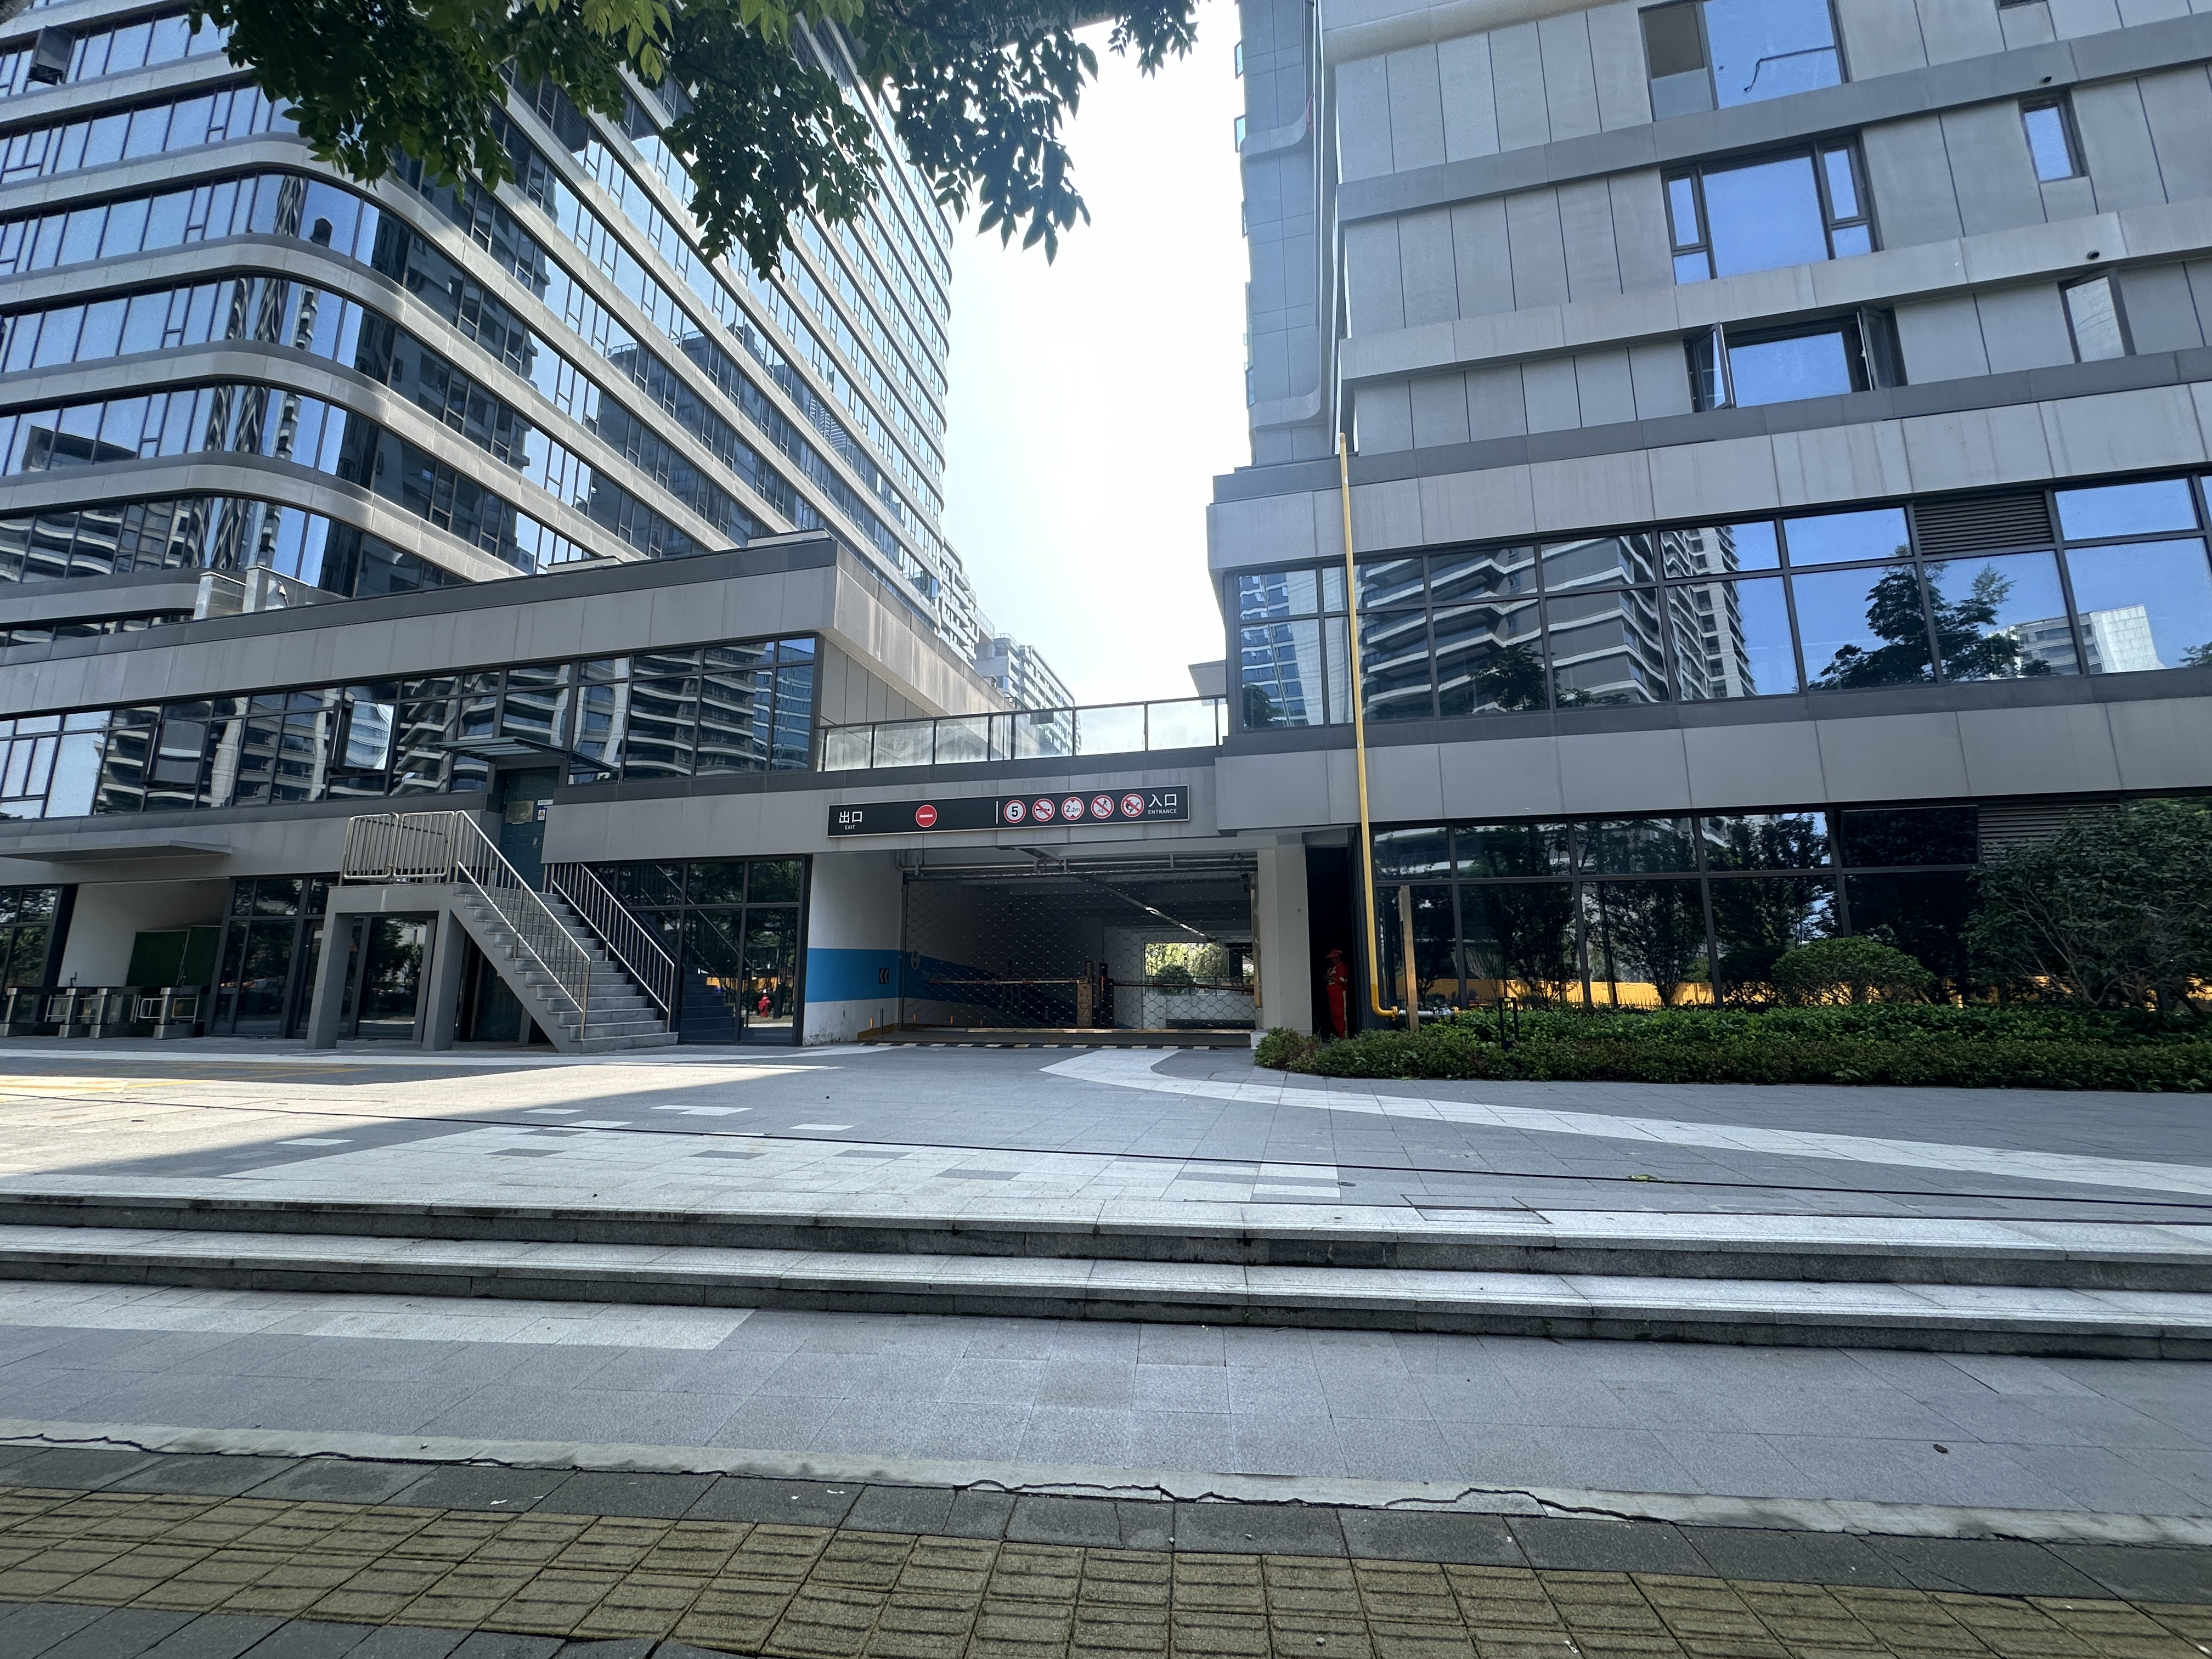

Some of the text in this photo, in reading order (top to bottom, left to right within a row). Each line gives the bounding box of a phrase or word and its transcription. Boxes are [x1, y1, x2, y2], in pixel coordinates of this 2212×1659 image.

[1148, 793, 1177, 807] 入口
[839, 810, 862, 823] 出口
[1012, 806, 1018, 817] 5
